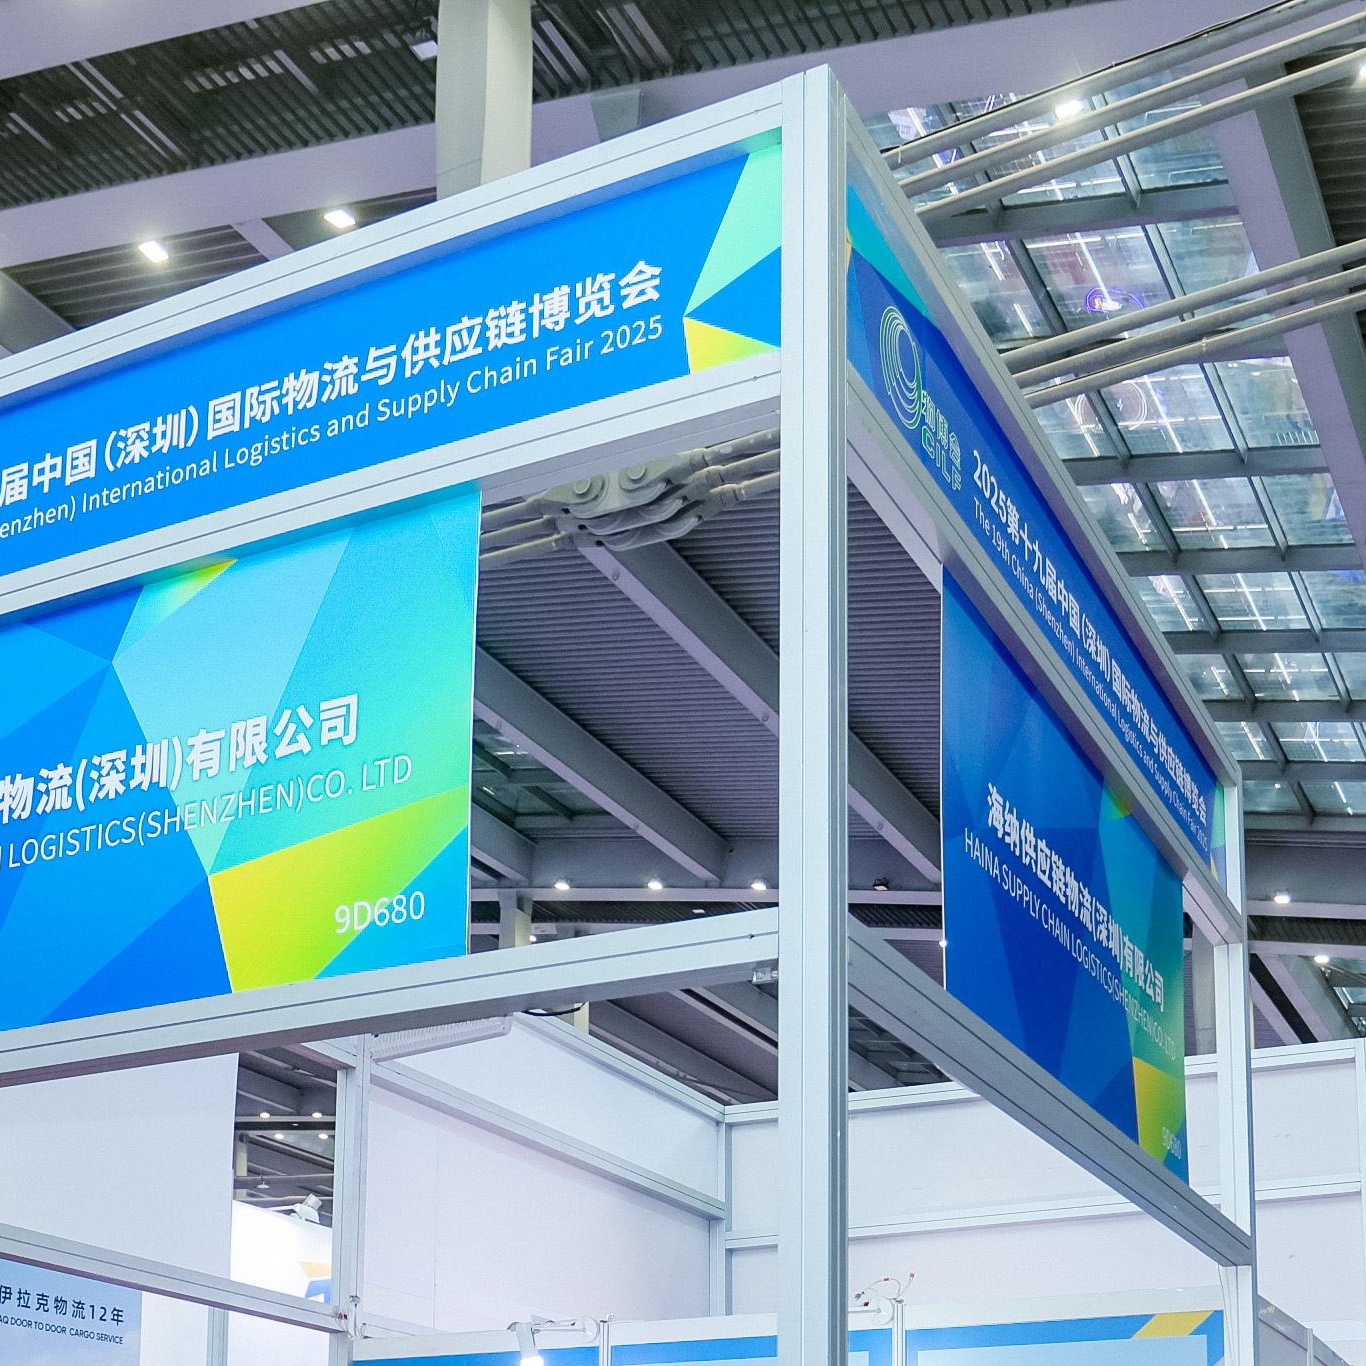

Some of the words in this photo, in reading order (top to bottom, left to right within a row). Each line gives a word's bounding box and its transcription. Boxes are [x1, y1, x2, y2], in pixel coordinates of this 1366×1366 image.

[83, 459, 218, 513] International
[225, 424, 320, 470] Logistics
[327, 404, 370, 437] and
[377, 379, 461, 423] Supply
[467, 351, 537, 393] Chain
[546, 341, 594, 371] Fair
[600, 314, 663, 355] 2025
[974, 496, 990, 537] The
[992, 526, 1010, 561] 19th
[1012, 554, 1034, 601] China
[1035, 588, 1076, 663] (Shenzhen)
[1076, 648, 1118, 715] International
[1117, 710, 1143, 758] Logistics
[1154, 763, 1173, 804] Supply
[361, 754, 413, 792] LTD
[334, 890, 426, 935] 9D680
[965, 827, 999, 886] HAINA
[1002, 864, 1040, 921] SUPPLY
[1042, 904, 1070, 950] CHAIN
[10, 1316, 33, 1329] DOOR
[34, 1320, 44, 1330] TO
[45, 1323, 67, 1335] DOOR
[69, 1327, 95, 1340] CARGO
[96, 1333, 124, 1345] SERVICE
